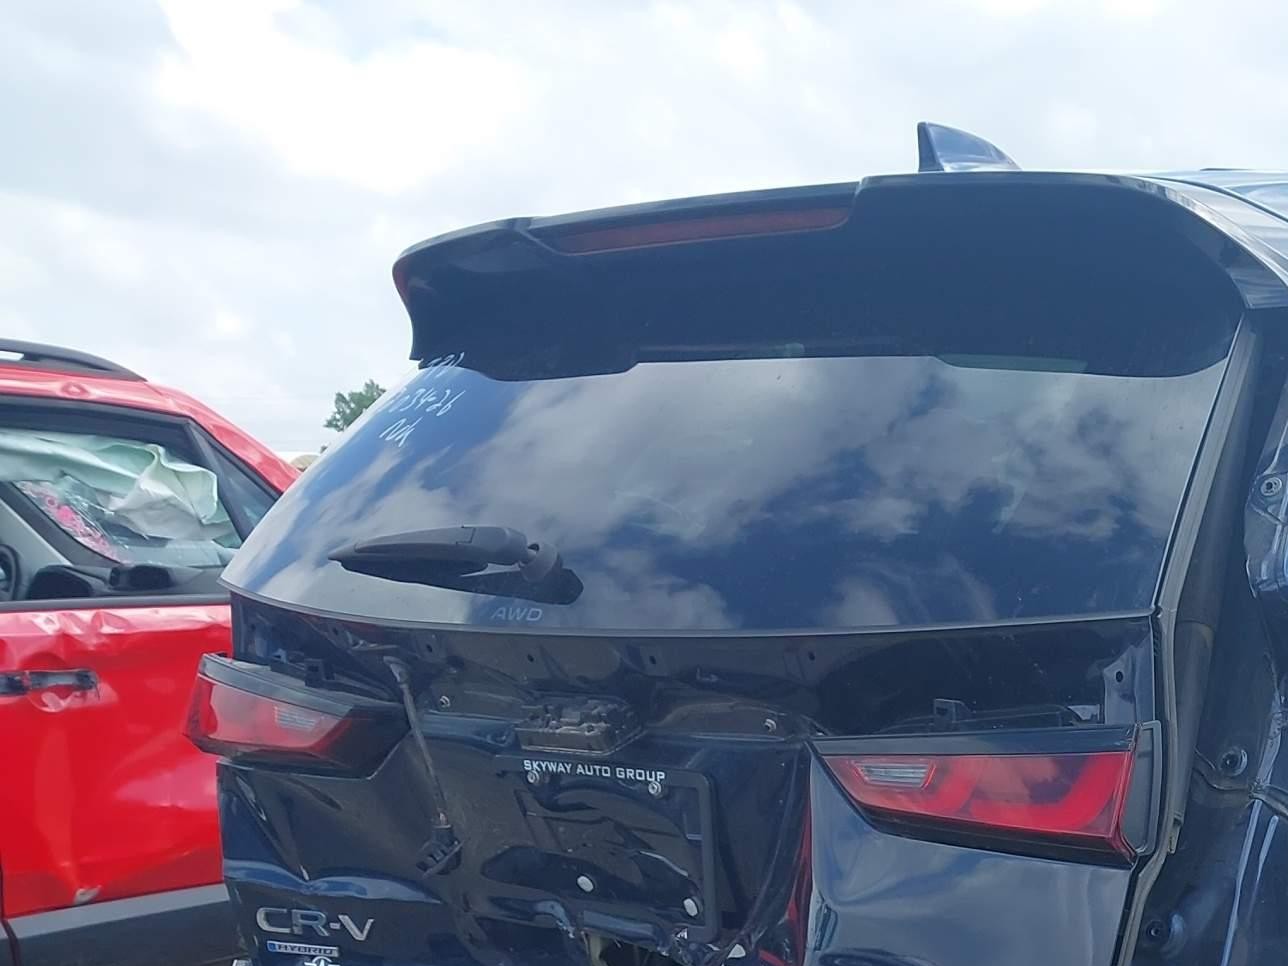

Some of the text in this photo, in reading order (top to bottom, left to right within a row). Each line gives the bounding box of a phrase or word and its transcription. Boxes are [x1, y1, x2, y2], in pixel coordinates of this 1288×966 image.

[490, 607, 543, 621] AWD
[523, 759, 666, 782] SKYWAY AUTO GROUP
[256, 907, 375, 941] CR-V
